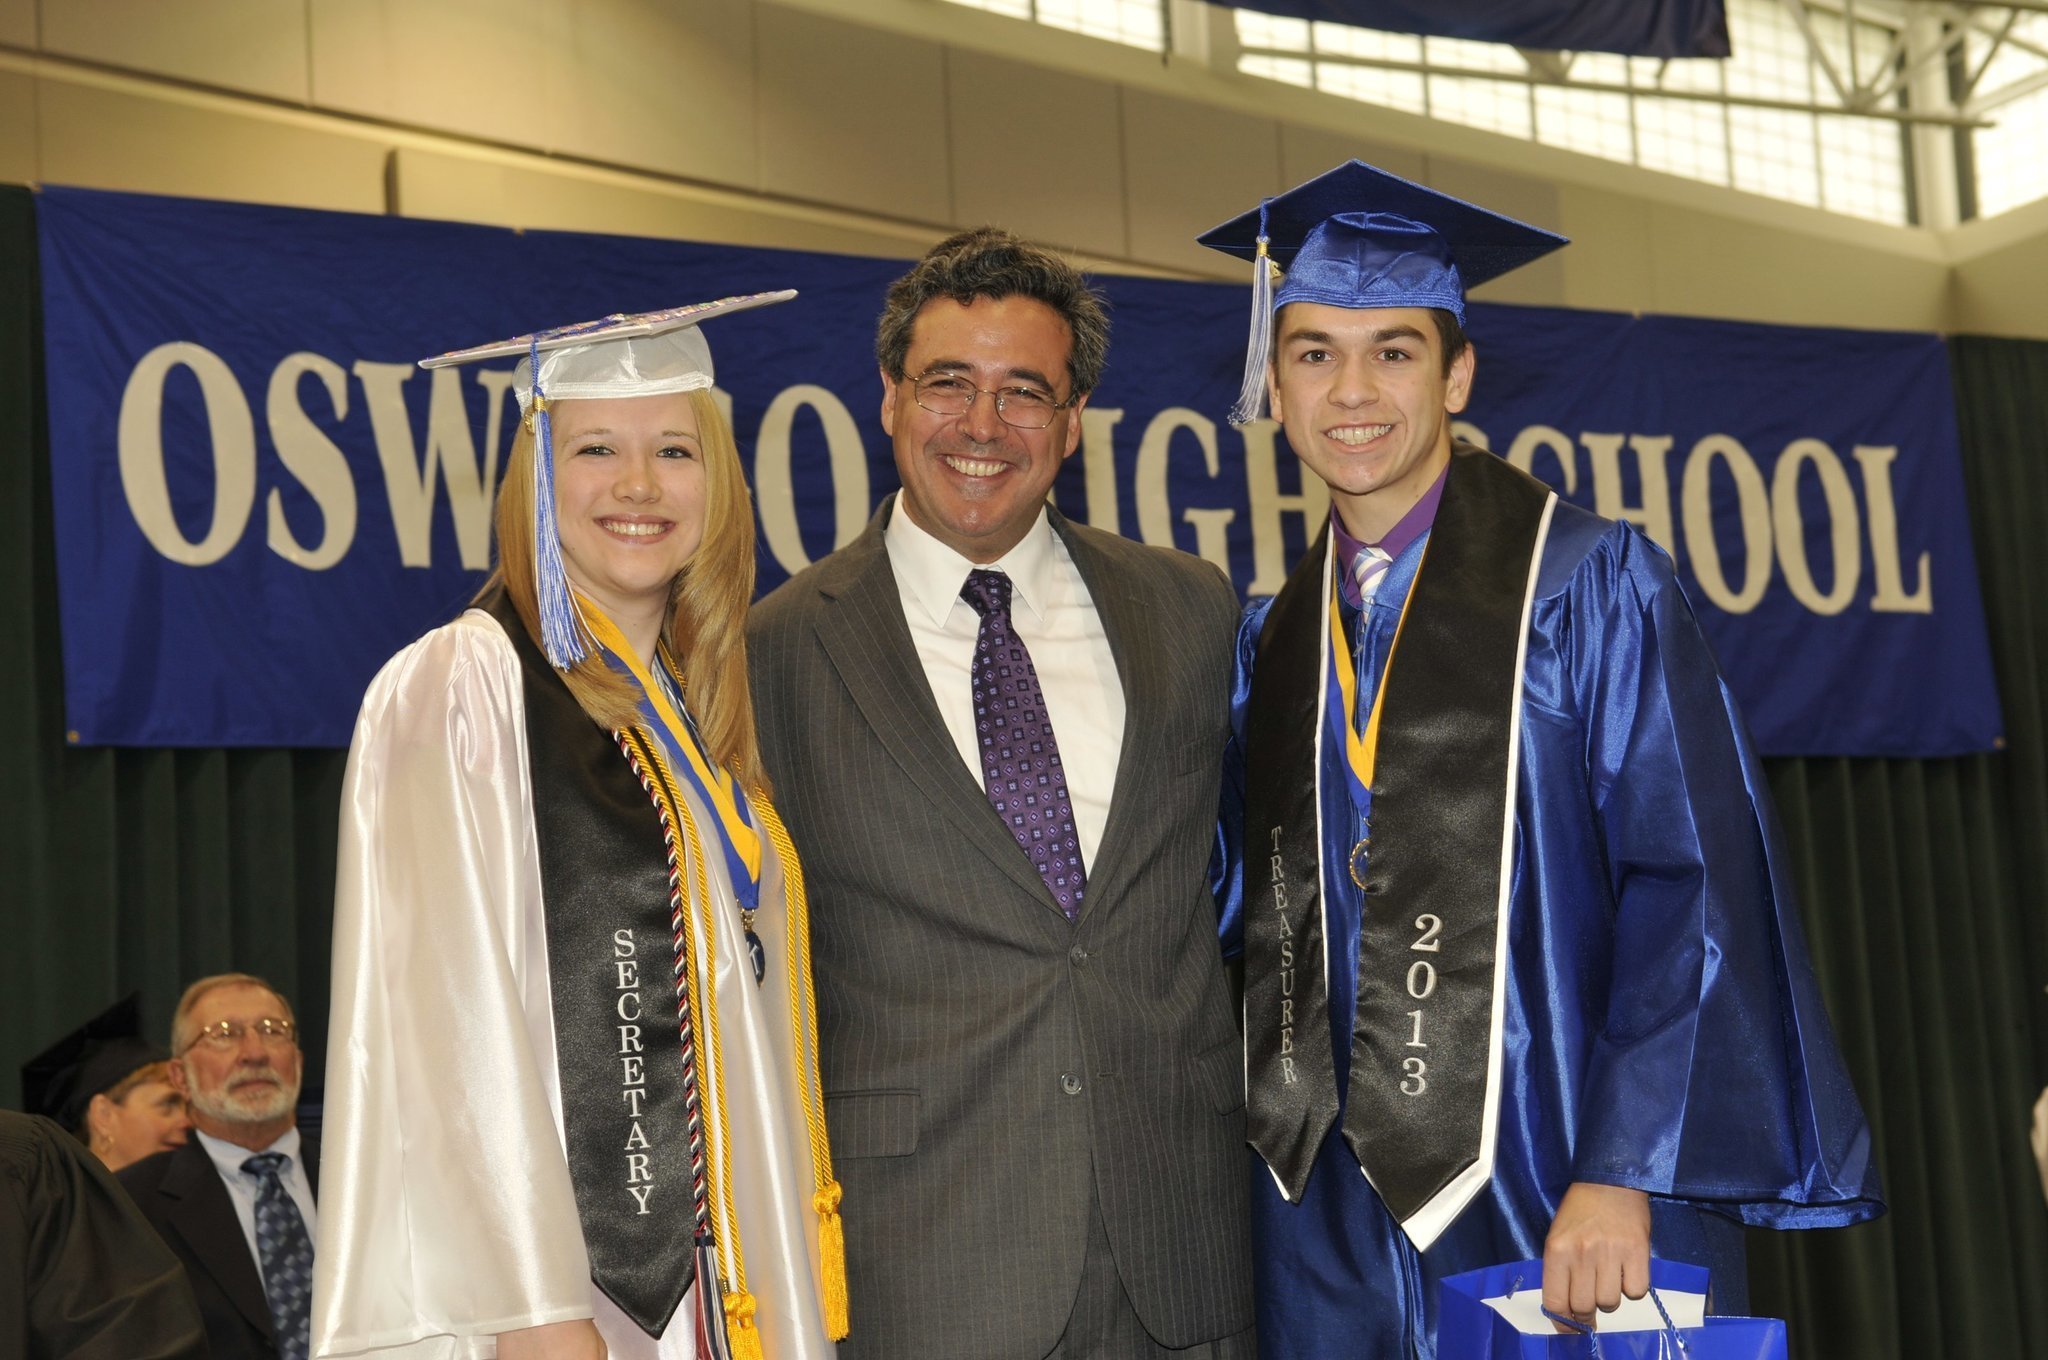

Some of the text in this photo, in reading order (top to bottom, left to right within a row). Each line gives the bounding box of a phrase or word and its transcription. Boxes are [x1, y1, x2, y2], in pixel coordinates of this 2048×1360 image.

[117, 340, 1933, 616] OSWO IGH HOOL
[613, 928, 651, 1215] SECRETARY
[1270, 825, 1298, 1085] TREASURER
[1399, 913, 1443, 1097] 2013
